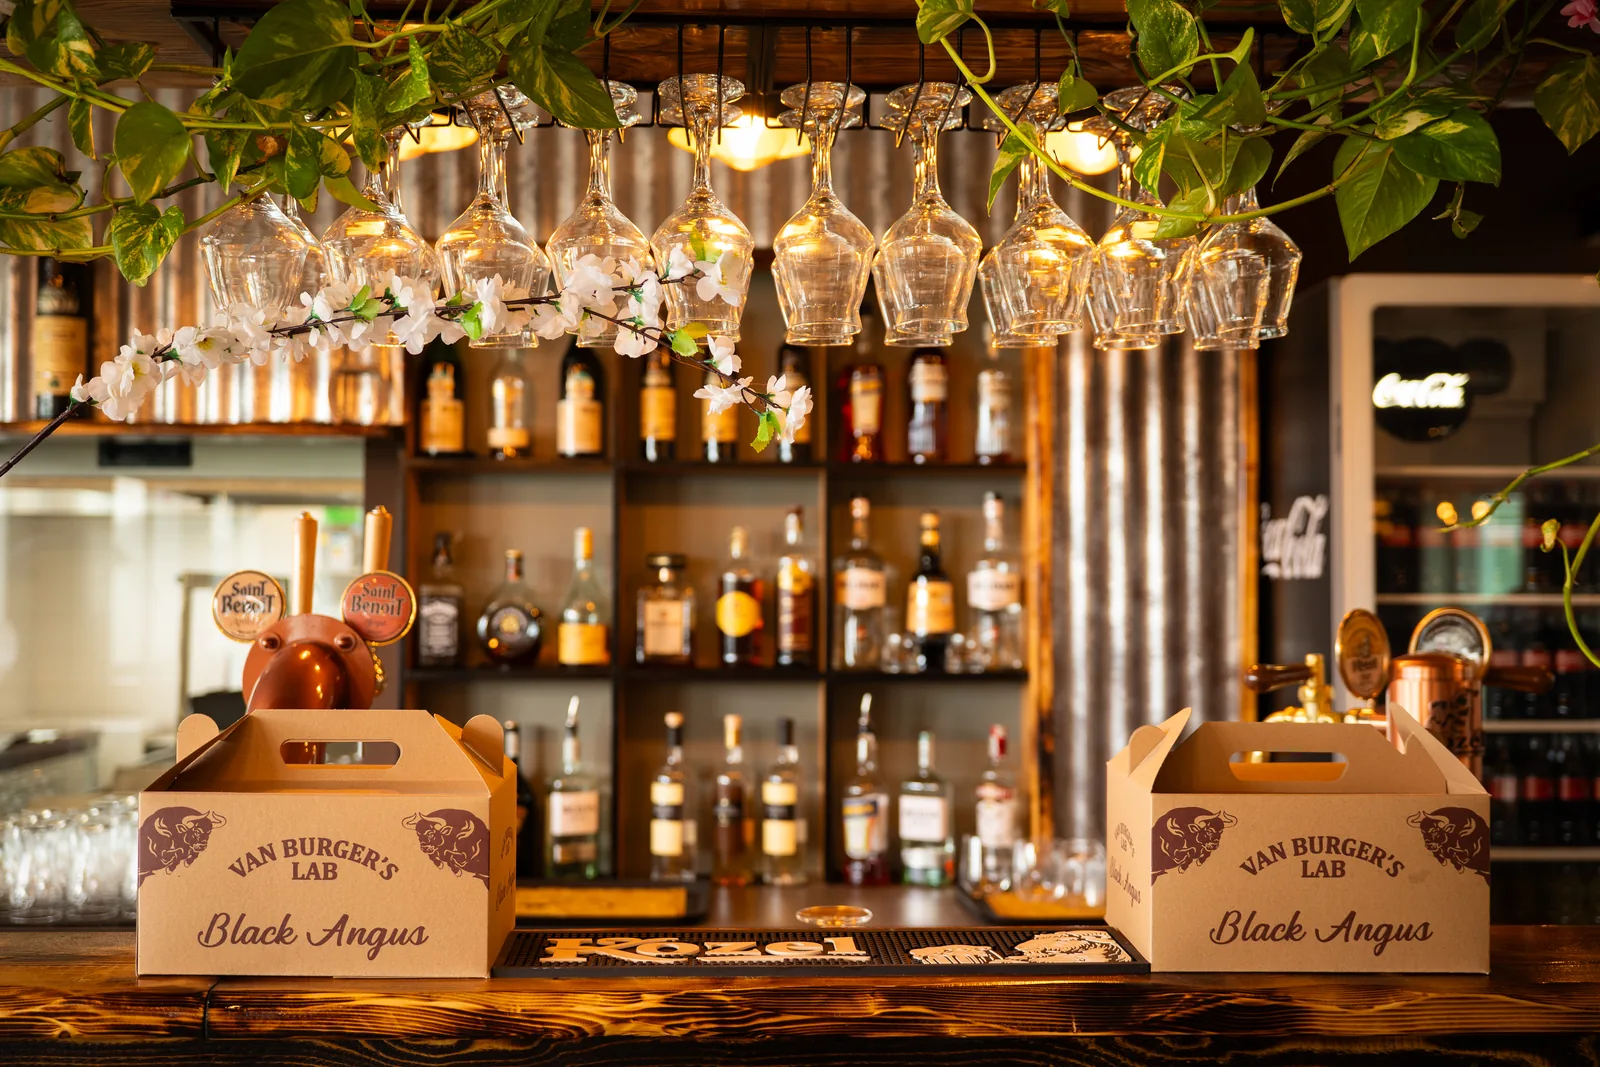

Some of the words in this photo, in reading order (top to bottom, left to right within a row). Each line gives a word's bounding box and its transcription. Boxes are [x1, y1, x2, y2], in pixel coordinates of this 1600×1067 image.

[227, 842, 277, 878] VAN
[281, 837, 400, 881] BURGER'S
[291, 861, 338, 881] LAB
[1239, 841, 1287, 877] VAN
[1291, 835, 1405, 878] BURGER'S
[1301, 859, 1346, 878] LAB
[197, 912, 298, 948] Black
[306, 913, 429, 961] Angus
[1209, 909, 1307, 945] Black
[1314, 910, 1434, 957] Angus
